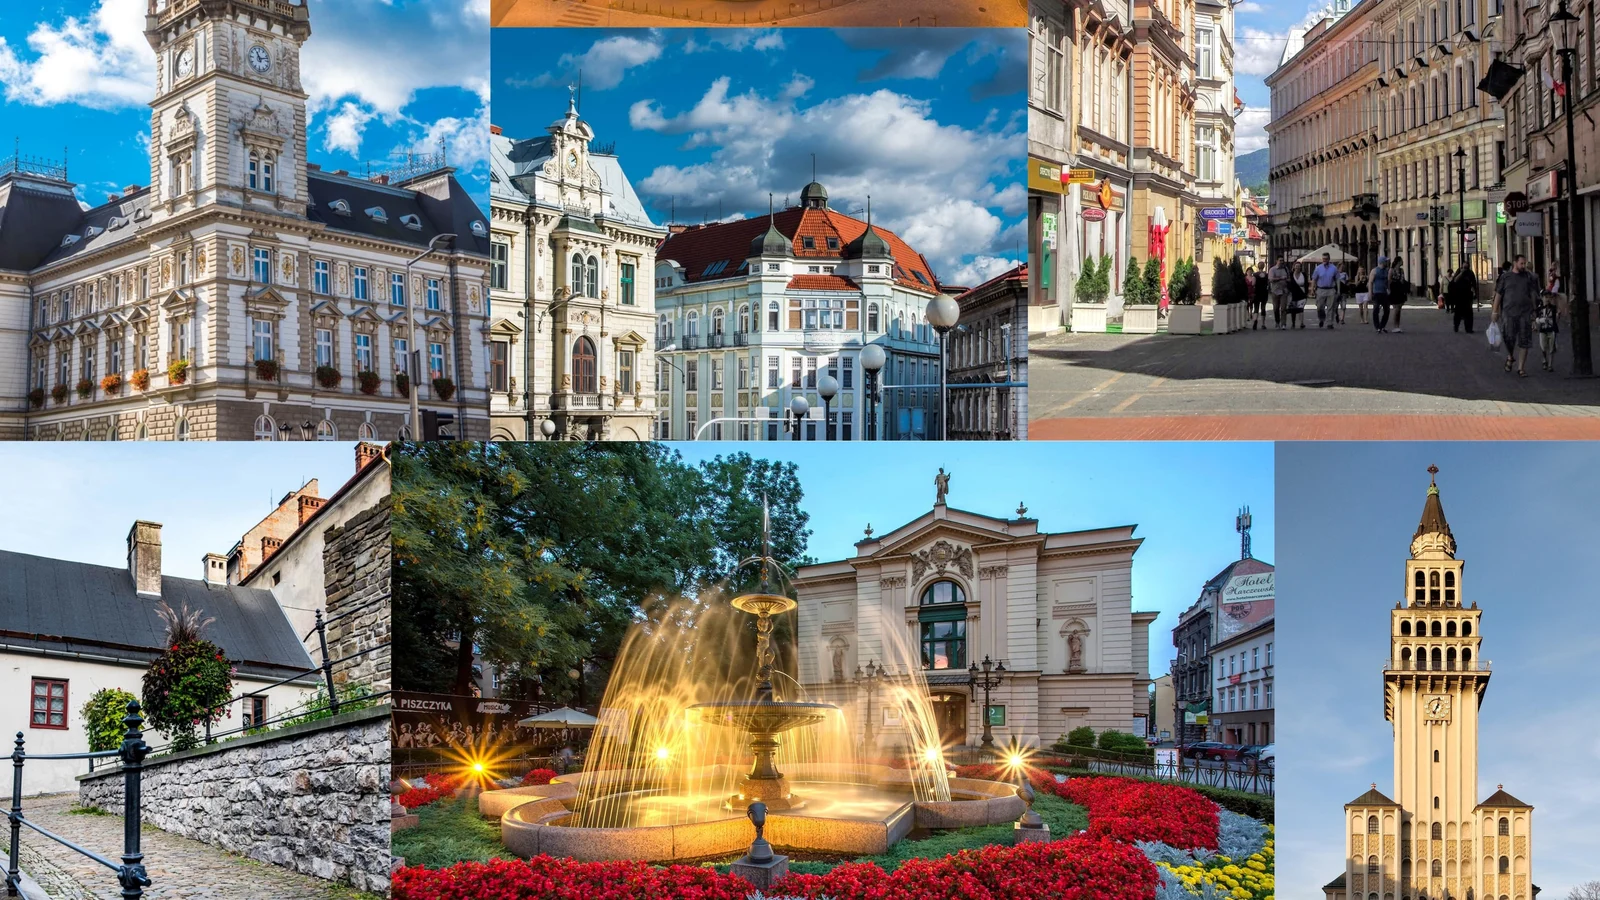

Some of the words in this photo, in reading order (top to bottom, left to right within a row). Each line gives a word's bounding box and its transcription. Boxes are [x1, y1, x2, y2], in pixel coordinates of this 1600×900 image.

[1506, 200, 1527, 209] STOP
[1235, 574, 1272, 587] Hotel
[401, 699, 452, 711] PISZCZYKA
